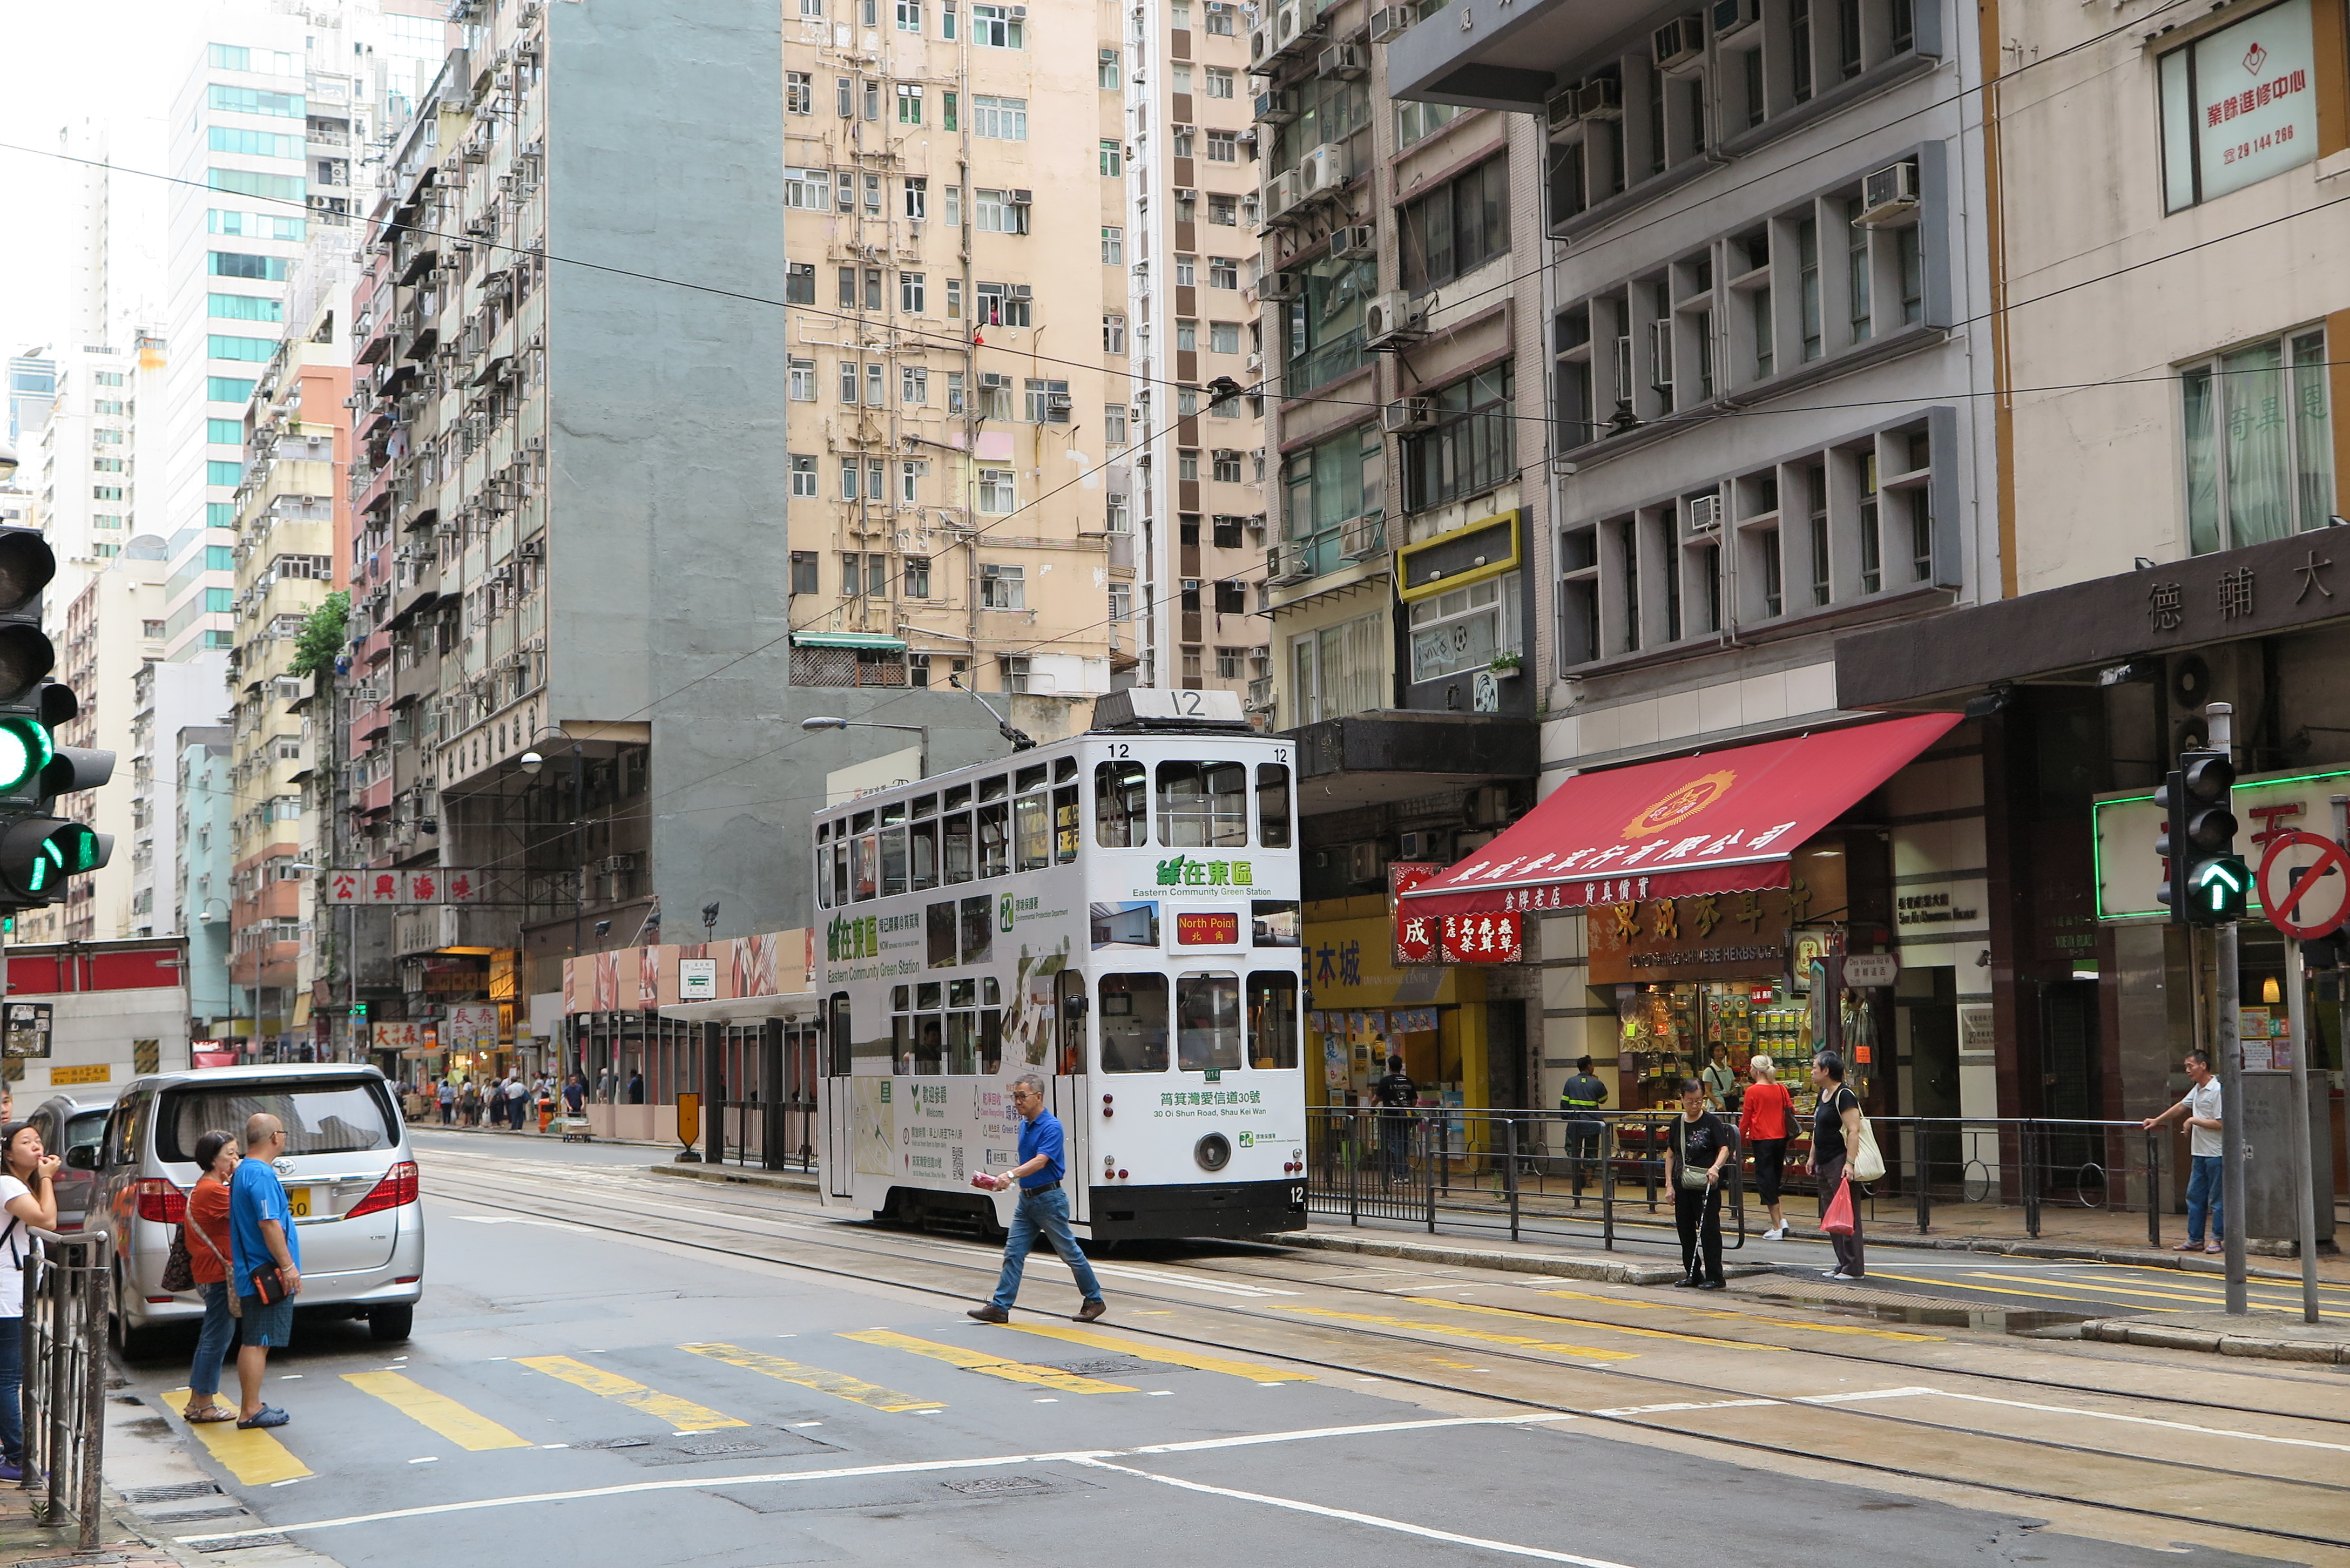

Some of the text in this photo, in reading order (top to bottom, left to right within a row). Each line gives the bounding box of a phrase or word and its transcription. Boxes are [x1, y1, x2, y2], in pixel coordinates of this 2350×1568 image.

[2207, 69, 2306, 128] 業餘進修中心
[2237, 125, 2293, 159] 29 144 266
[1171, 691, 1205, 716] 12
[1108, 744, 1130, 758] 12
[1273, 748, 1287, 763] 12
[1156, 854, 1253, 886] 綠在東區
[333, 873, 474, 901] 公興海味
[1133, 889, 1167, 897] Eastern
[1170, 887, 1218, 897] Community
[1246, 887, 1271, 895] Station
[1585, 876, 1649, 903] 貨真價實
[1504, 886, 1561, 910] 金牌老店
[1179, 917, 1236, 929] North Point
[1446, 917, 1456, 938] 老店
[827, 910, 878, 962] 綠在東區
[1191, 931, 1224, 942] 北角
[1460, 918, 1476, 954] 名茶
[1478, 917, 1495, 954] 鹿茸
[1497, 917, 1514, 952] 蟲草
[879, 941, 889, 950] NOW
[1682, 948, 1721, 965] CHINESE
[1723, 945, 1755, 962] HERBS
[828, 958, 920, 983] Eastern Community Green Station
[1363, 972, 1429, 986] JAPAN HOME CENTRE
[453, 1008, 495, 1025] 長泰
[1160, 1090, 1261, 1106] 筲箕灣愛信道30號
[926, 1107, 944, 1118] Welcome
[989, 1110, 1004, 1119] Recycling
[1153, 1110, 1163, 1118] 30
[1197, 1109, 1219, 1118] Road,
[1002, 1125, 1014, 1134] Green
[1291, 1187, 1304, 1204] 12
